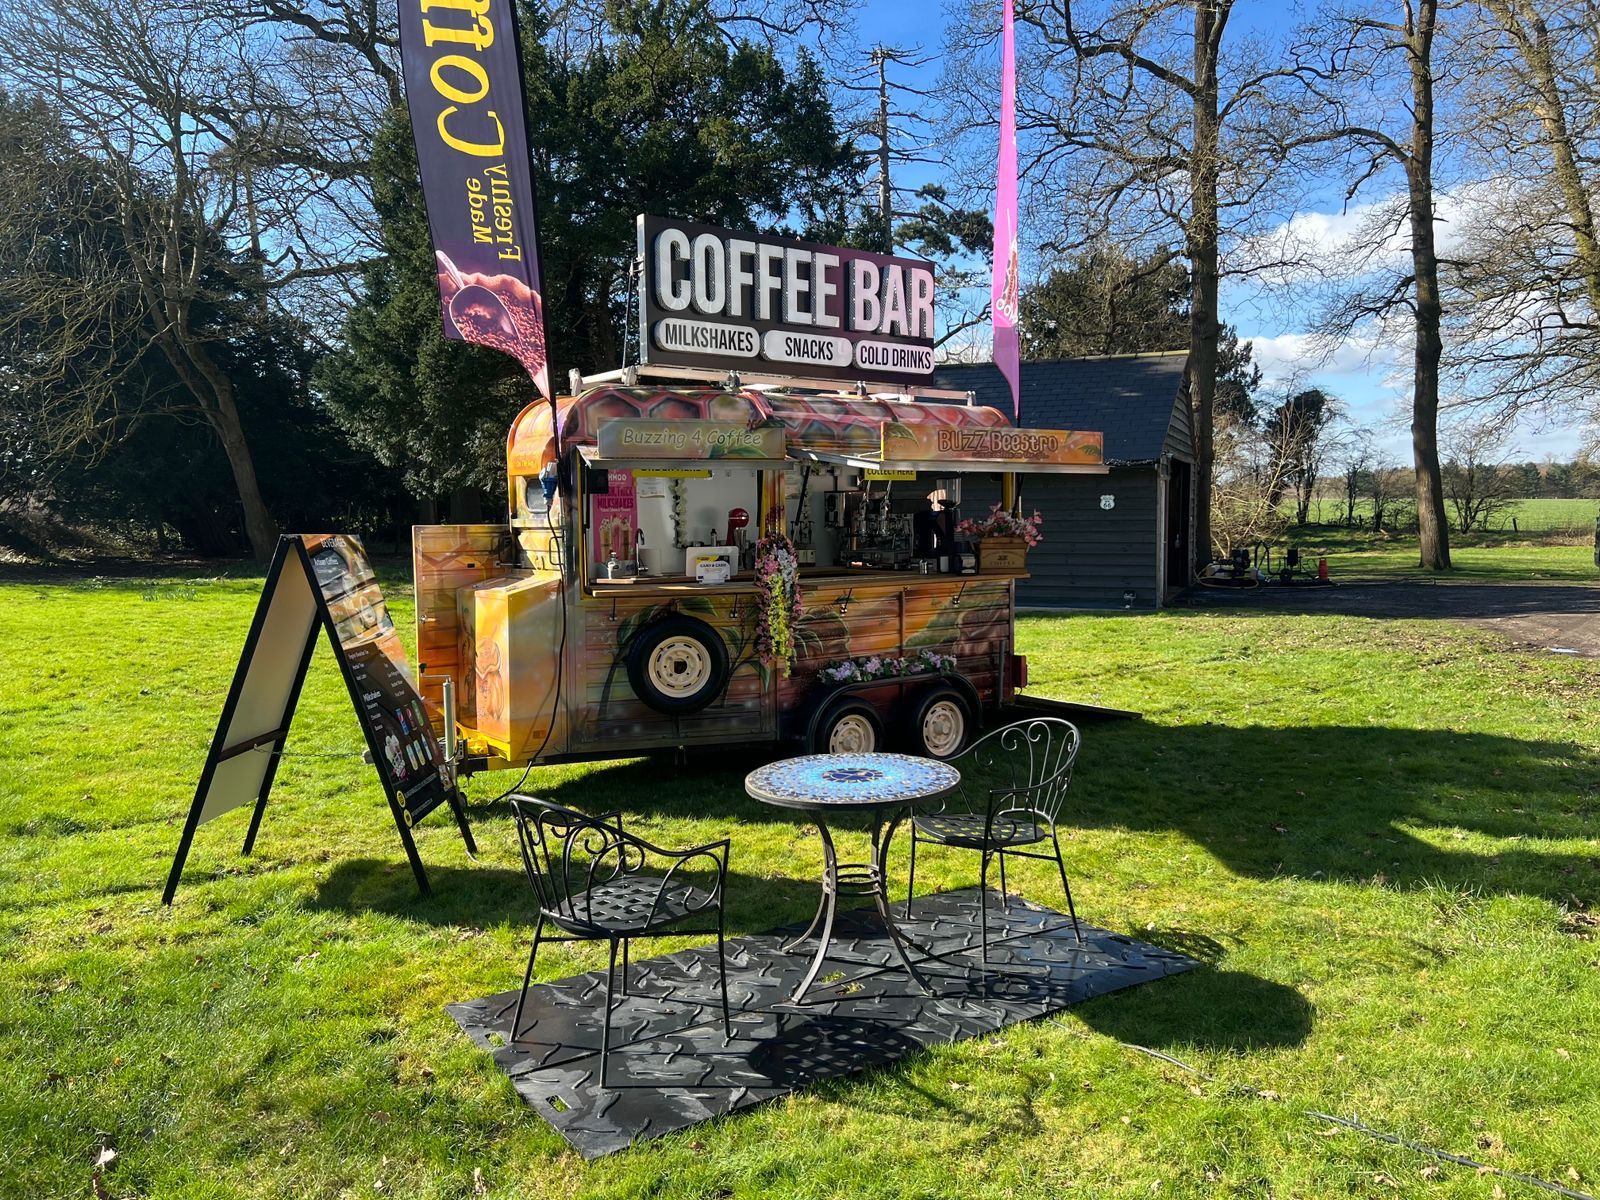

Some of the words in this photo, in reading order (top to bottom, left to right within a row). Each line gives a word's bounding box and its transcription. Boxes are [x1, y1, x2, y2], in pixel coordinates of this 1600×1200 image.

[656, 228, 840, 328] COFFEE
[849, 258, 935, 339] BAR
[665, 323, 753, 352] MILKSHAKES
[785, 336, 834, 361] SNACKS
[860, 345, 889, 366] COLD
[892, 348, 931, 370] DRINKS
[623, 428, 686, 449] Buzzing
[691, 429, 701, 445] 4
[706, 428, 762, 445] Coffee
[990, 430, 1059, 452] Beestro
